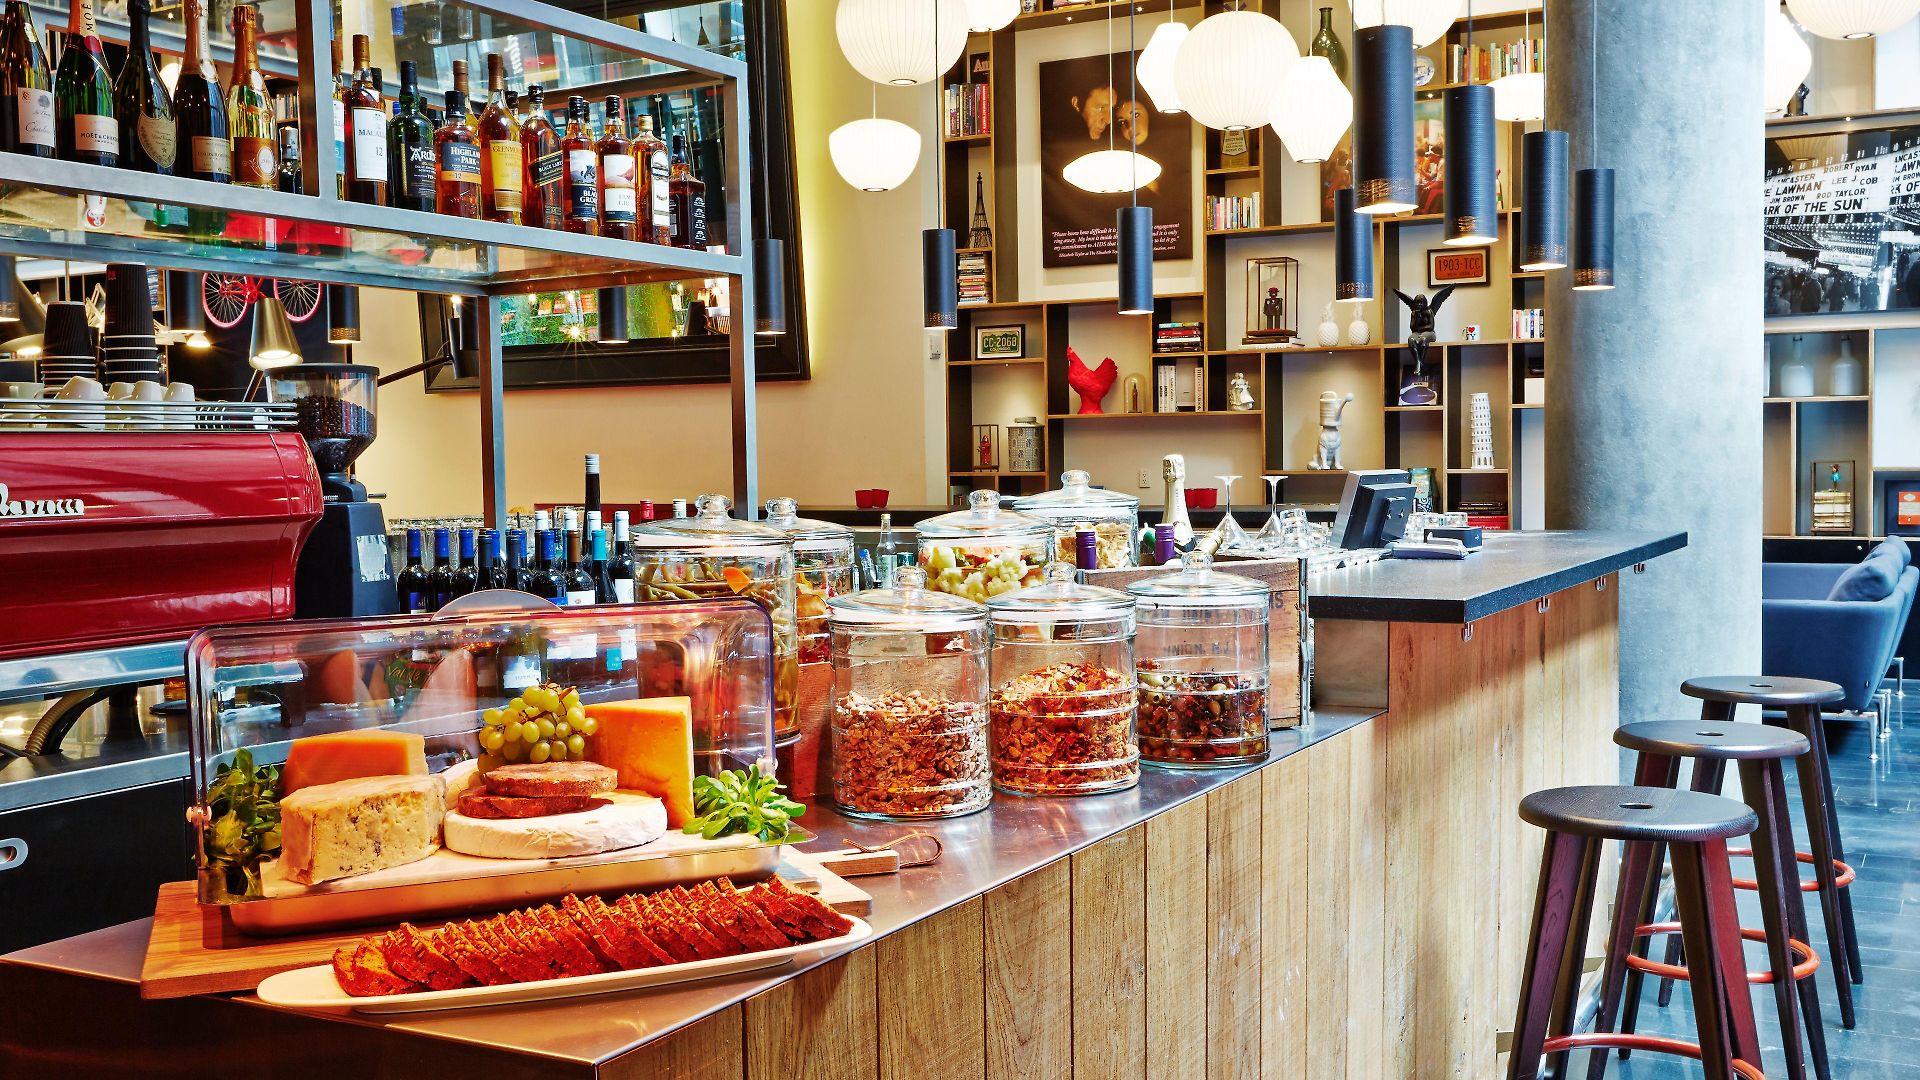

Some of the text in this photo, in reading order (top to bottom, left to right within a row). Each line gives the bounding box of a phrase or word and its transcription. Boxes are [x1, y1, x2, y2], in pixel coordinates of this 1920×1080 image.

[82, 3, 94, 33] MOË
[375, 147, 383, 157] 12
[461, 156, 477, 166] PARK
[539, 163, 553, 172] BLACK
[1824, 163, 1855, 173] ROBERT
[1855, 163, 1877, 173] RYAN
[1775, 181, 1822, 195] LAWMAN
[1906, 180, 1920, 192] OF
[1835, 188, 1866, 197] TAYLOR
[1764, 204, 1781, 215] ARK
[1784, 203, 1799, 214] OF
[1804, 201, 1828, 213] THE
[1090, 227, 1107, 235] difficult
[1154, 222, 1179, 230] engagement
[1438, 257, 1481, 271] 1903-TCC
[983, 336, 1017, 348] CC-2068
